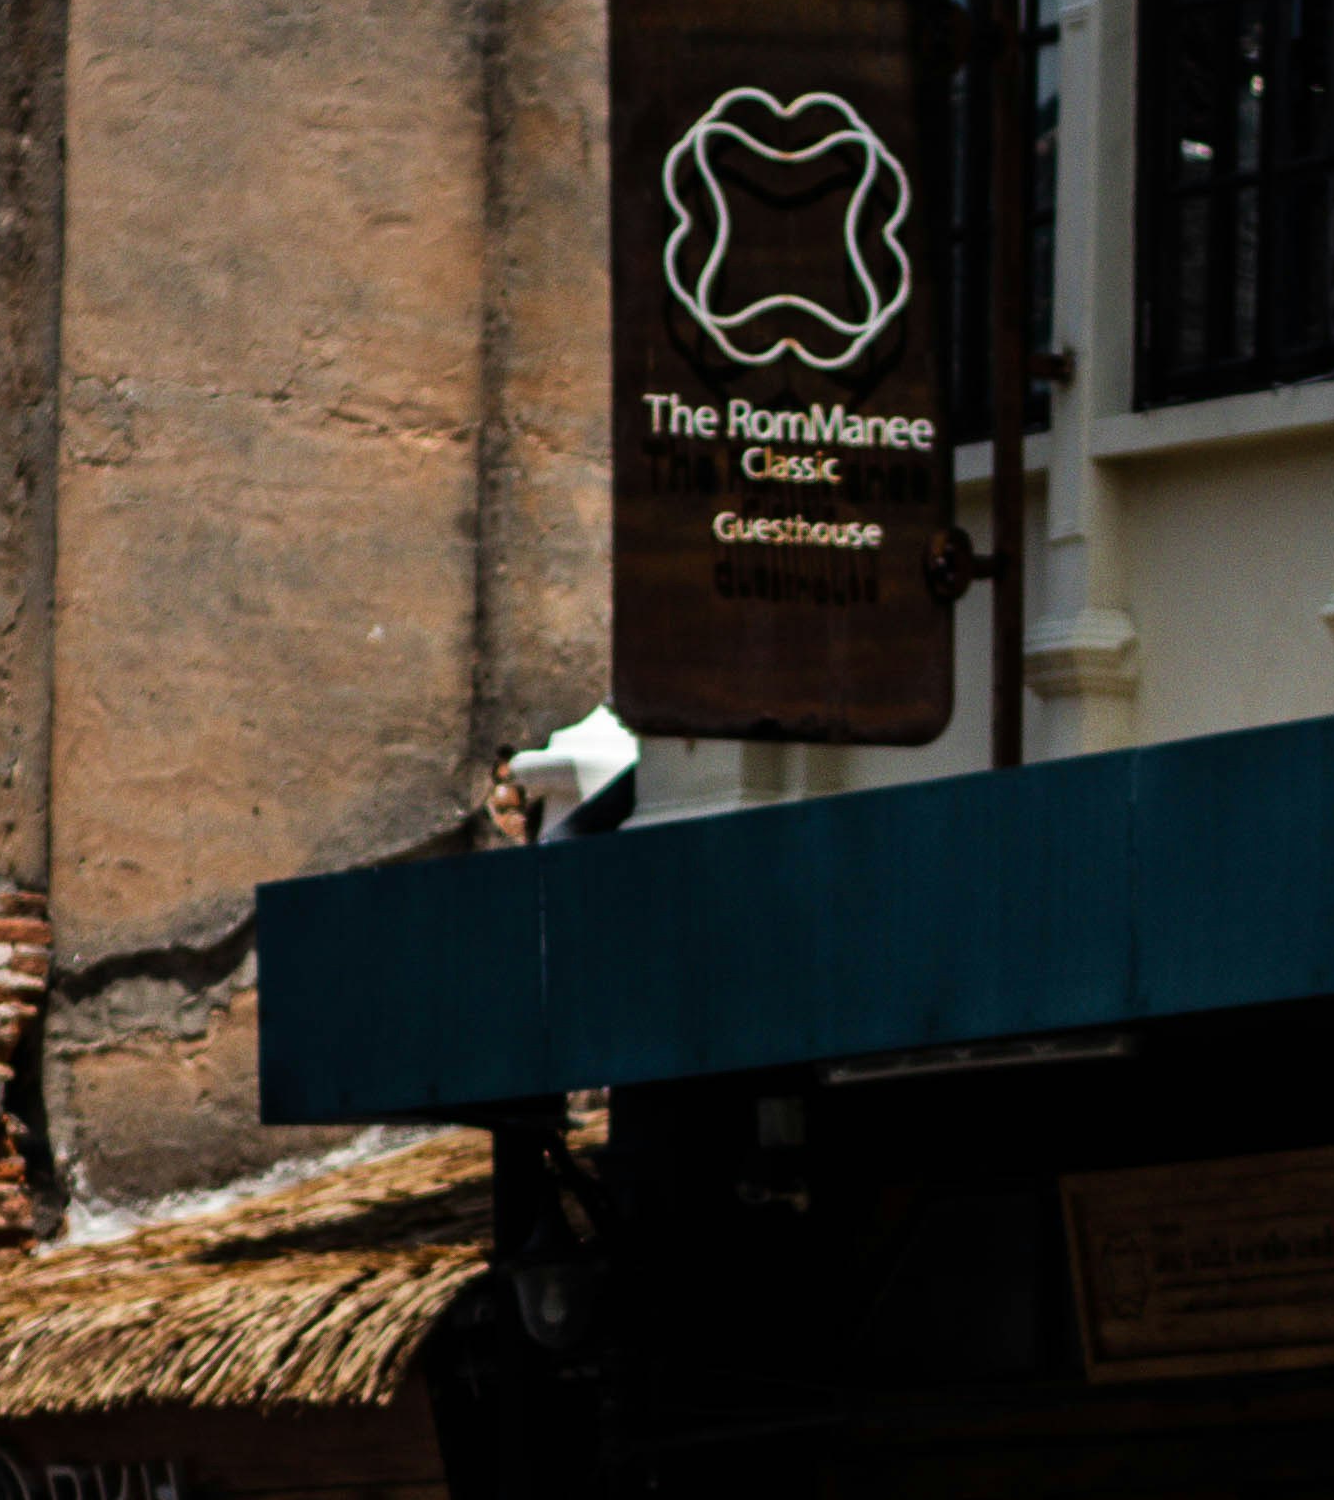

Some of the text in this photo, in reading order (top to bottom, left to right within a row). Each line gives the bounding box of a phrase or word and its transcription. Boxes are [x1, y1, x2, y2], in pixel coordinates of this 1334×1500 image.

[642, 392, 935, 452] The RomManee
[740, 445, 843, 484] Classic
[712, 510, 885, 550] Guesthouse
